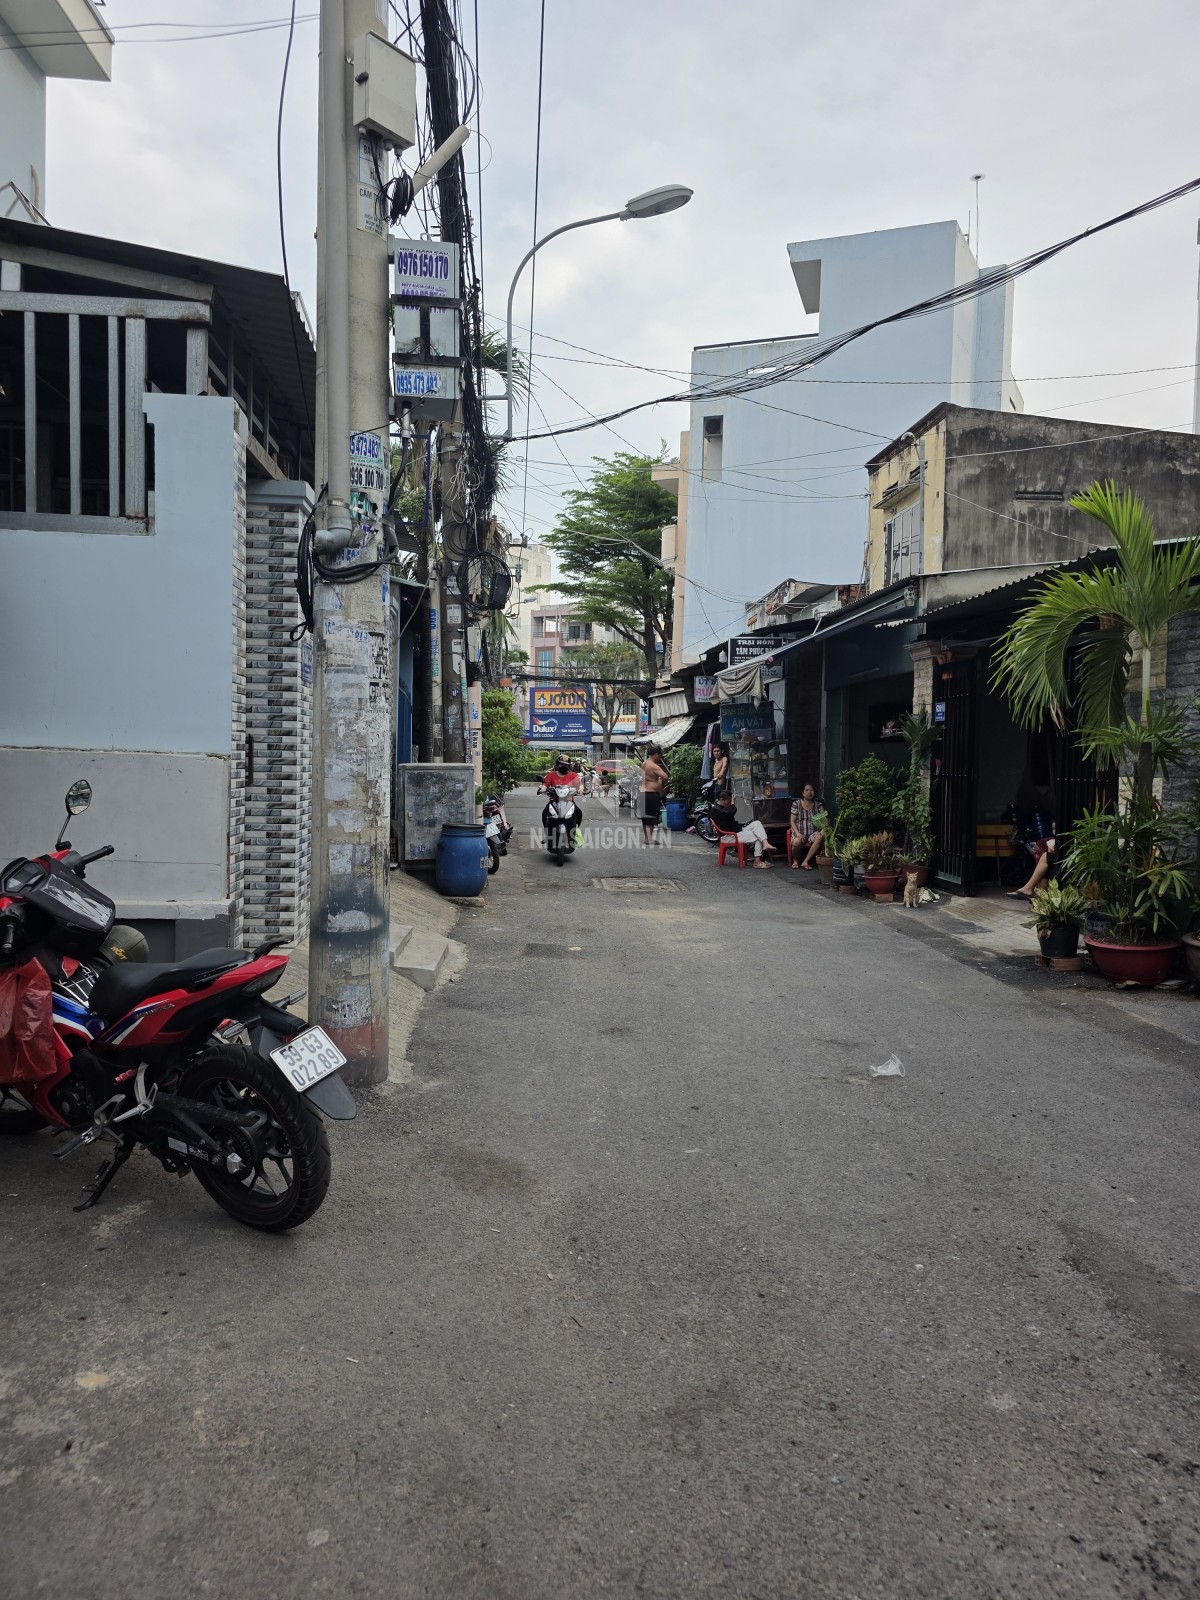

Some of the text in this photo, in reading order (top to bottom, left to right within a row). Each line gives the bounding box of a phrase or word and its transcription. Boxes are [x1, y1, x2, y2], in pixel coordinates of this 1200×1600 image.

[398, 252, 449, 280] 0976.150.170
[548, 693, 585, 706] JOTUN
[533, 724, 556, 733] Dulux
[279, 1033, 324, 1067] 59-G3
[291, 1048, 341, 1087] 022.89
